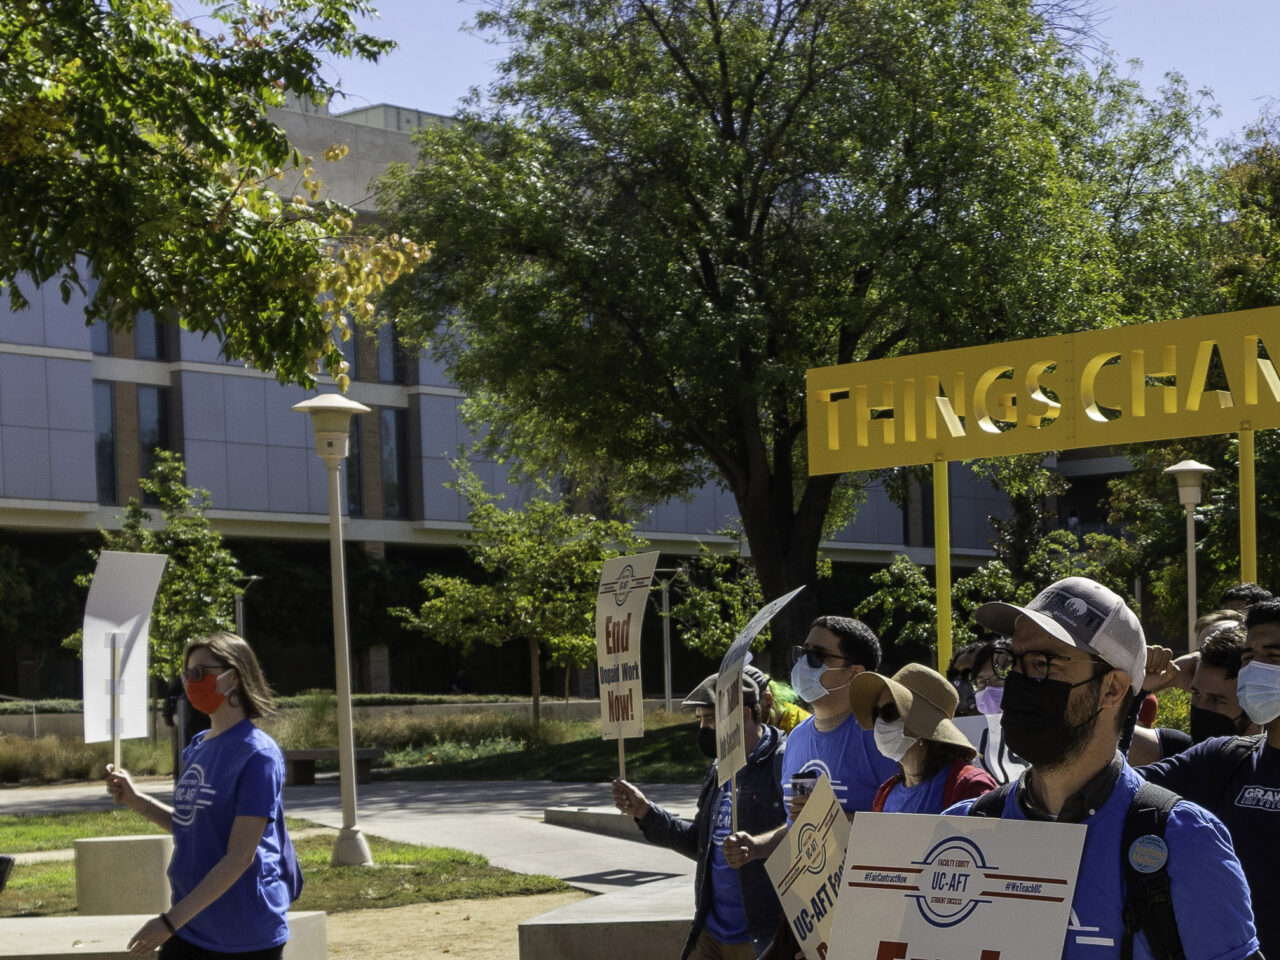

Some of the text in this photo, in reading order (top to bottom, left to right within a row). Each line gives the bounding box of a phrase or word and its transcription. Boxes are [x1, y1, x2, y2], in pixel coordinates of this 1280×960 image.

[815, 359, 1062, 450] THINGS
[605, 612, 632, 655] End
[621, 661, 640, 681] Work
[608, 688, 634, 723] Now!
[931, 871, 970, 892] UC-AFT
[1004, 881, 1042, 894] #WeTeachUC
[793, 881, 834, 941] UC-AFT
